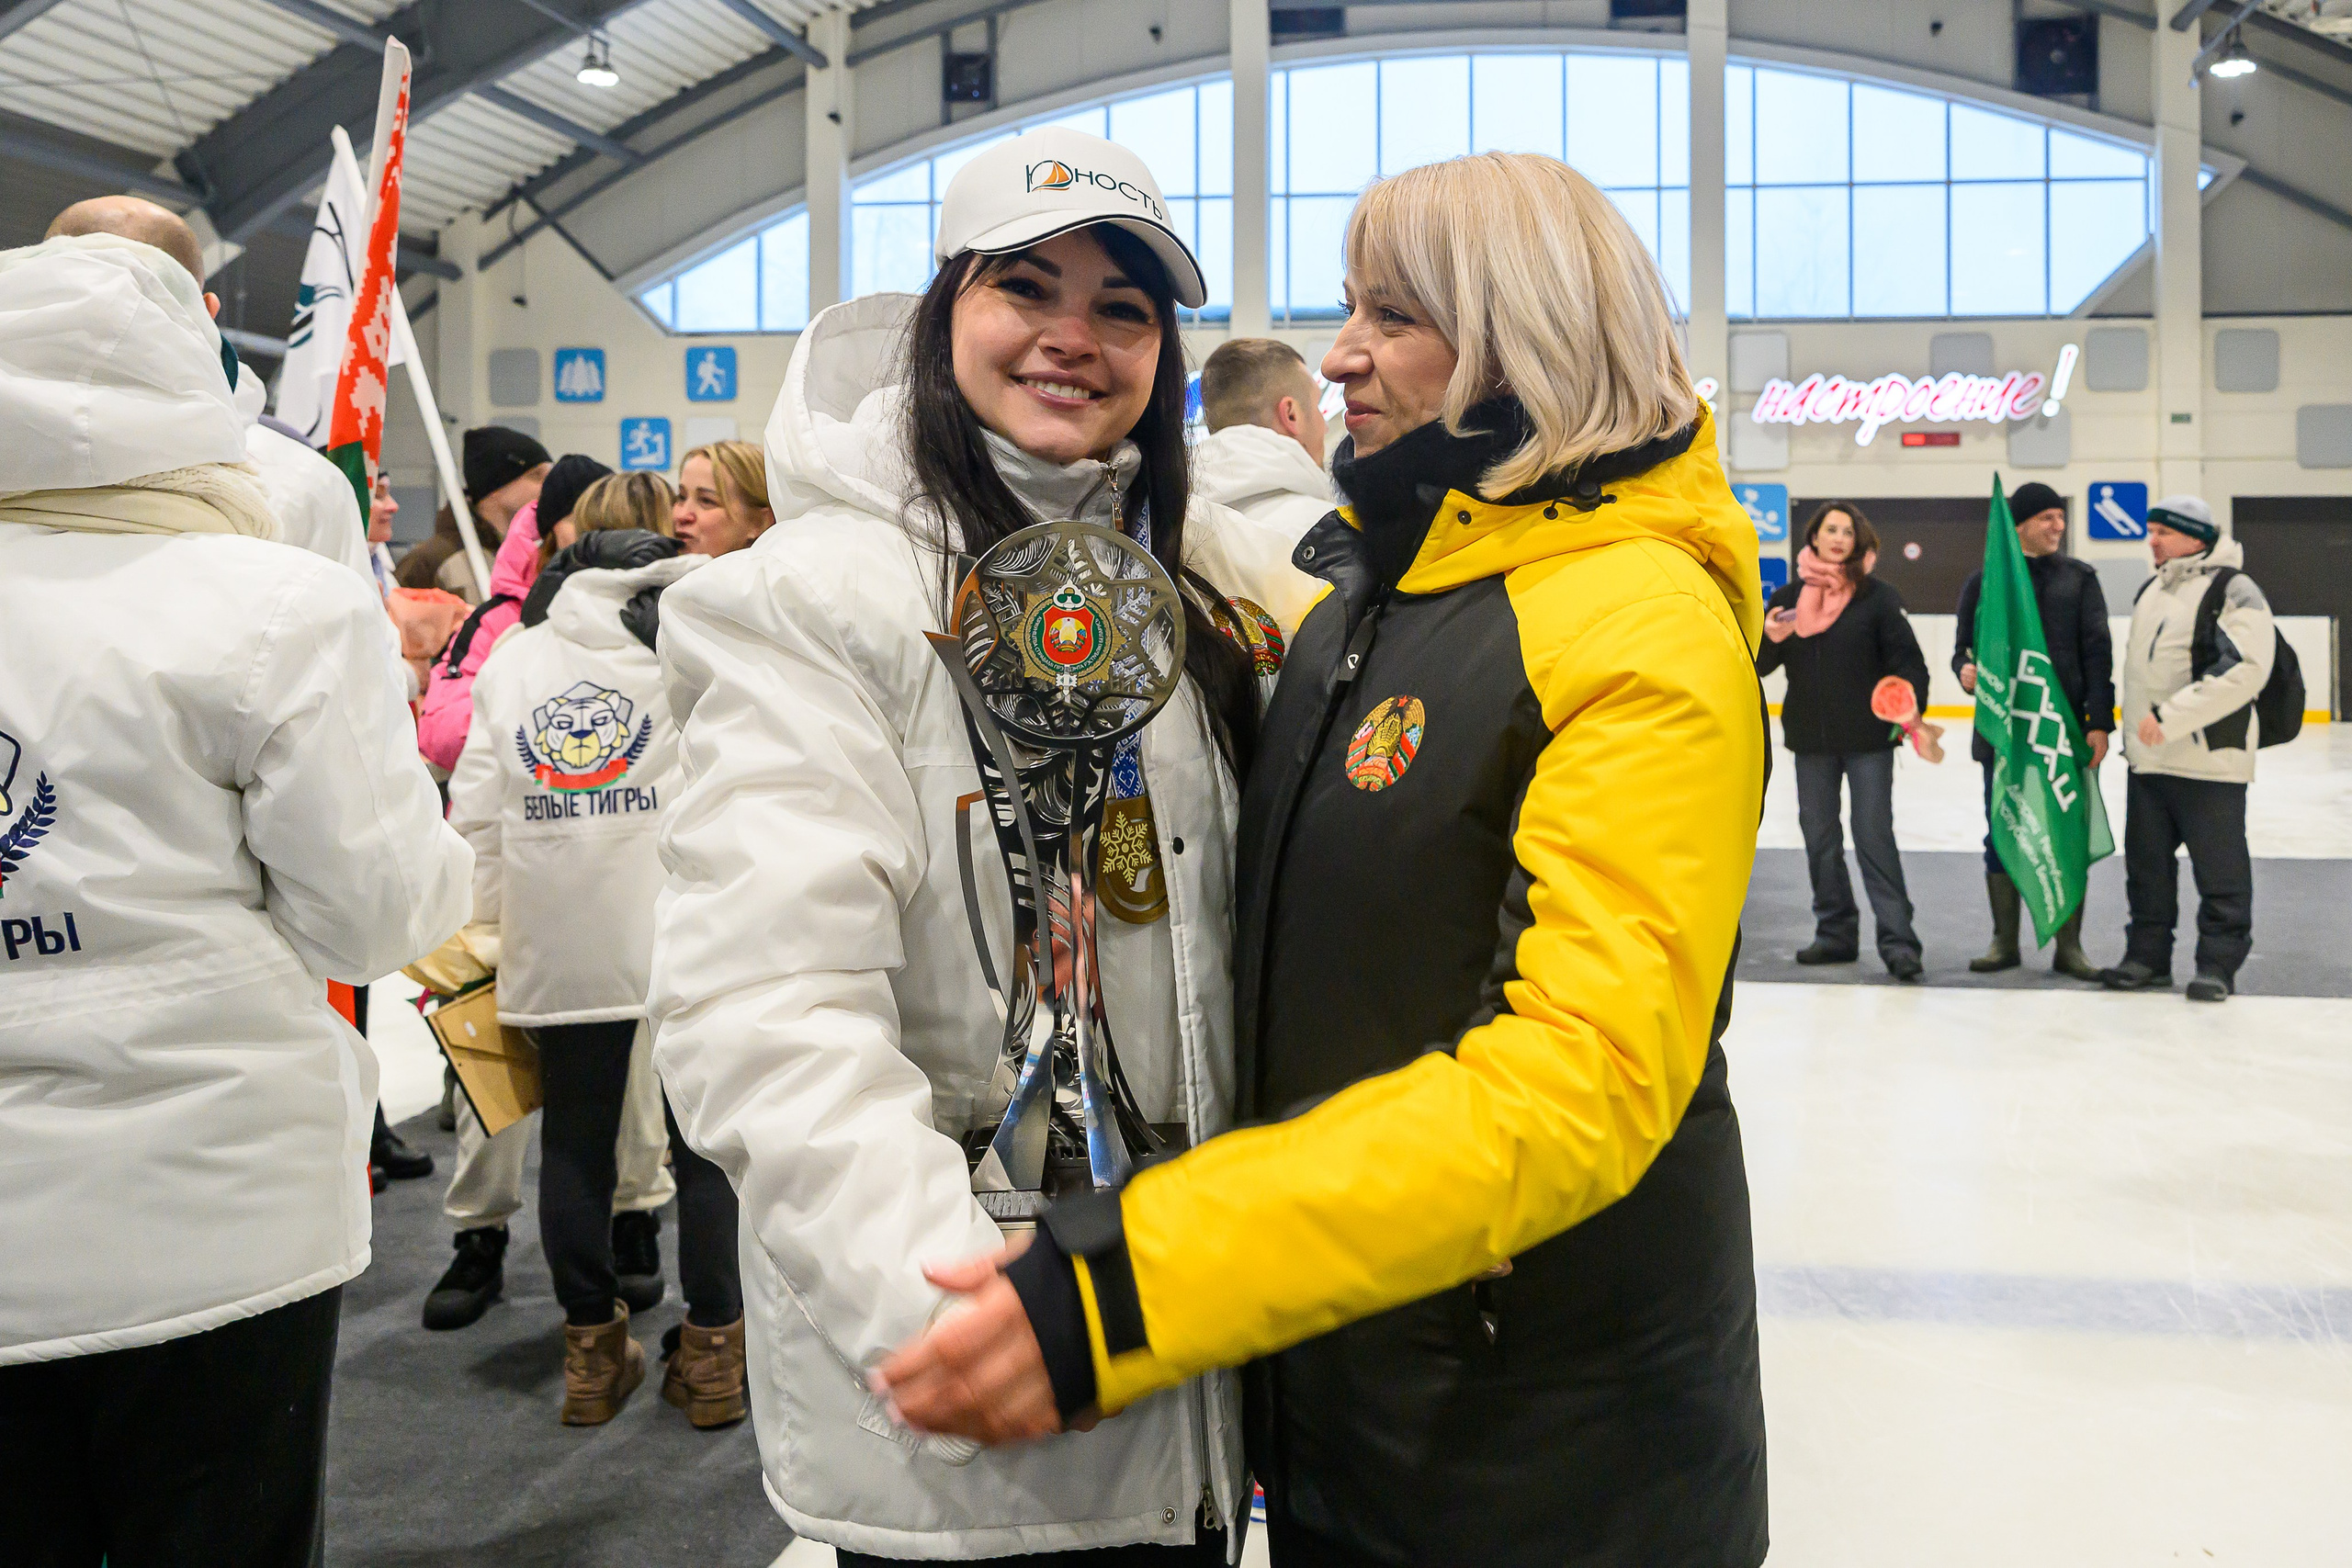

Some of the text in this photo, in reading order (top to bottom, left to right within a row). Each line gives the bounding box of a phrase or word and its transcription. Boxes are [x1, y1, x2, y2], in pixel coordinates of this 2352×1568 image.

[1025, 160, 1163, 220] ЮНОСТЬ
[525, 785, 658, 820] БЕЛЫЕ ТИГРЫ
